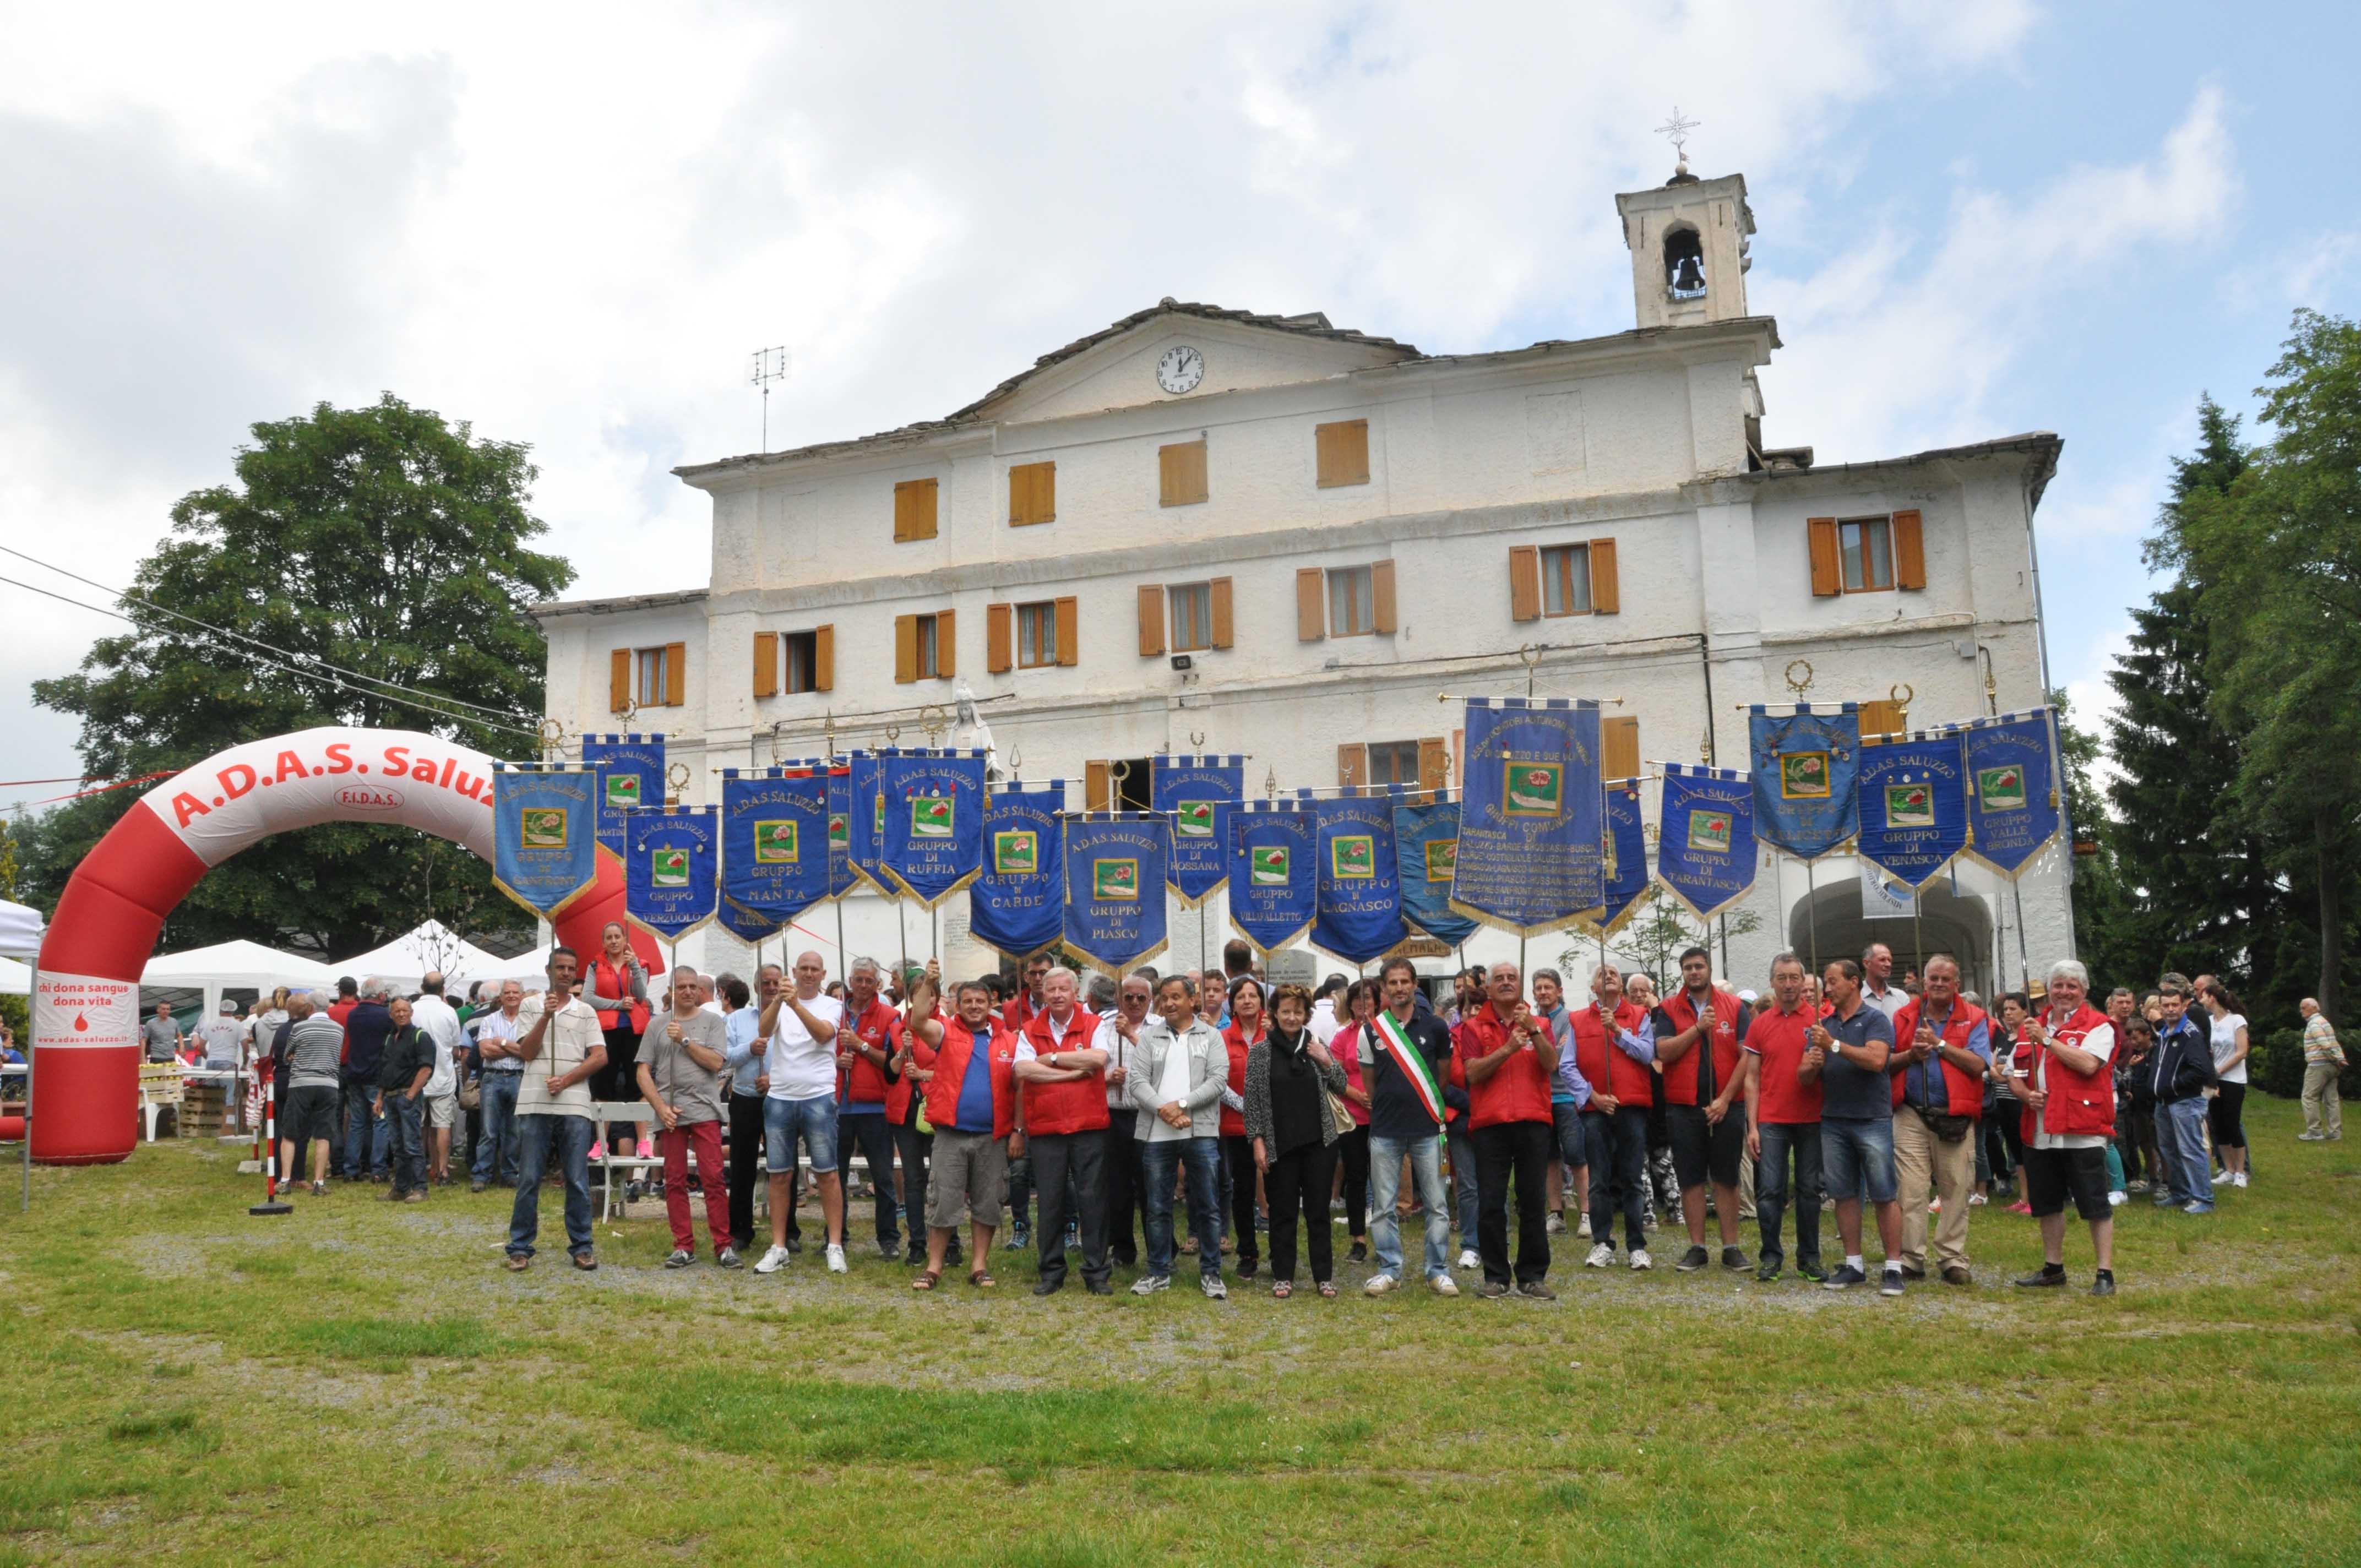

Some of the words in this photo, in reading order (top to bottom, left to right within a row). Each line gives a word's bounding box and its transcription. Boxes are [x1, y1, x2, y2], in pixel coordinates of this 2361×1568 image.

[1990, 732, 2043, 753] SALUZZO
[619, 750, 657, 769] SALUZZO
[1535, 750, 1540, 760] E
[1543, 751, 1560, 761] SUE
[1900, 756, 1955, 779] SALUZZO
[931, 767, 977, 790] SALUZZO
[1193, 772, 1234, 793] SALUZZO
[172, 743, 368, 829] A.D.A.S.
[383, 746, 493, 808] Saluz
[342, 791, 398, 807] F.I.D.A.S.
[771, 790, 820, 815] SALUZZO
[1011, 805, 1054, 828] SALUZZO
[1347, 810, 1391, 832] SALUZZO
[1484, 803, 1519, 830] GRUPPI
[1984, 813, 2032, 829] GRUPPO
[667, 820, 709, 842] SALUZZO
[1462, 826, 1506, 840] TARANTASCA
[1883, 830, 1939, 843] GRUPPO
[1990, 825, 2028, 839] VALLE
[1111, 832, 1157, 852] SALUZZO
[1525, 833, 1536, 842] DI
[1986, 836, 2035, 851] BRONDA
[907, 841, 958, 851] GRUPPO
[1174, 841, 1218, 850] GRUPPO
[1905, 843, 1919, 853] DI
[925, 853, 938, 862] DI
[1190, 851, 1201, 860] DI
[1683, 852, 1731, 867] GRUPPO
[1883, 854, 1943, 865] VENASCA
[752, 865, 803, 877] GRUPPO
[907, 863, 955, 874] RUFFIA
[1170, 862, 1220, 871] ROSSANA
[1700, 865, 1712, 875] DI
[772, 879, 782, 888] DI
[986, 873, 1048, 886] GRUPPO
[1321, 878, 1390, 891] GRUPPO
[1668, 872, 1742, 891] TARANTASCA
[1014, 886, 1021, 895] DI
[1249, 889, 1293, 899] GRUPPO
[1867, 868, 1902, 909] MISERICORDIO
[649, 891, 693, 901] GRUPPO
[748, 889, 806, 901] MANTA
[1352, 891, 1359, 900] DI
[665, 902, 676, 912] DI
[1090, 905, 1141, 916] GRUPPO
[1264, 900, 1275, 910] DI
[1322, 899, 1392, 913] LAGNASCO
[643, 913, 701, 923] VERZUOLO
[1111, 918, 1121, 927] DI
[1240, 912, 1302, 922] VILLAFALLETTO
[1092, 929, 1138, 939] PIASCO
[39, 983, 51, 993] chi
[53, 983, 84, 993] dona
[88, 984, 128, 995] sangue
[53, 996, 84, 1006] dona
[89, 996, 112, 1006] vita
